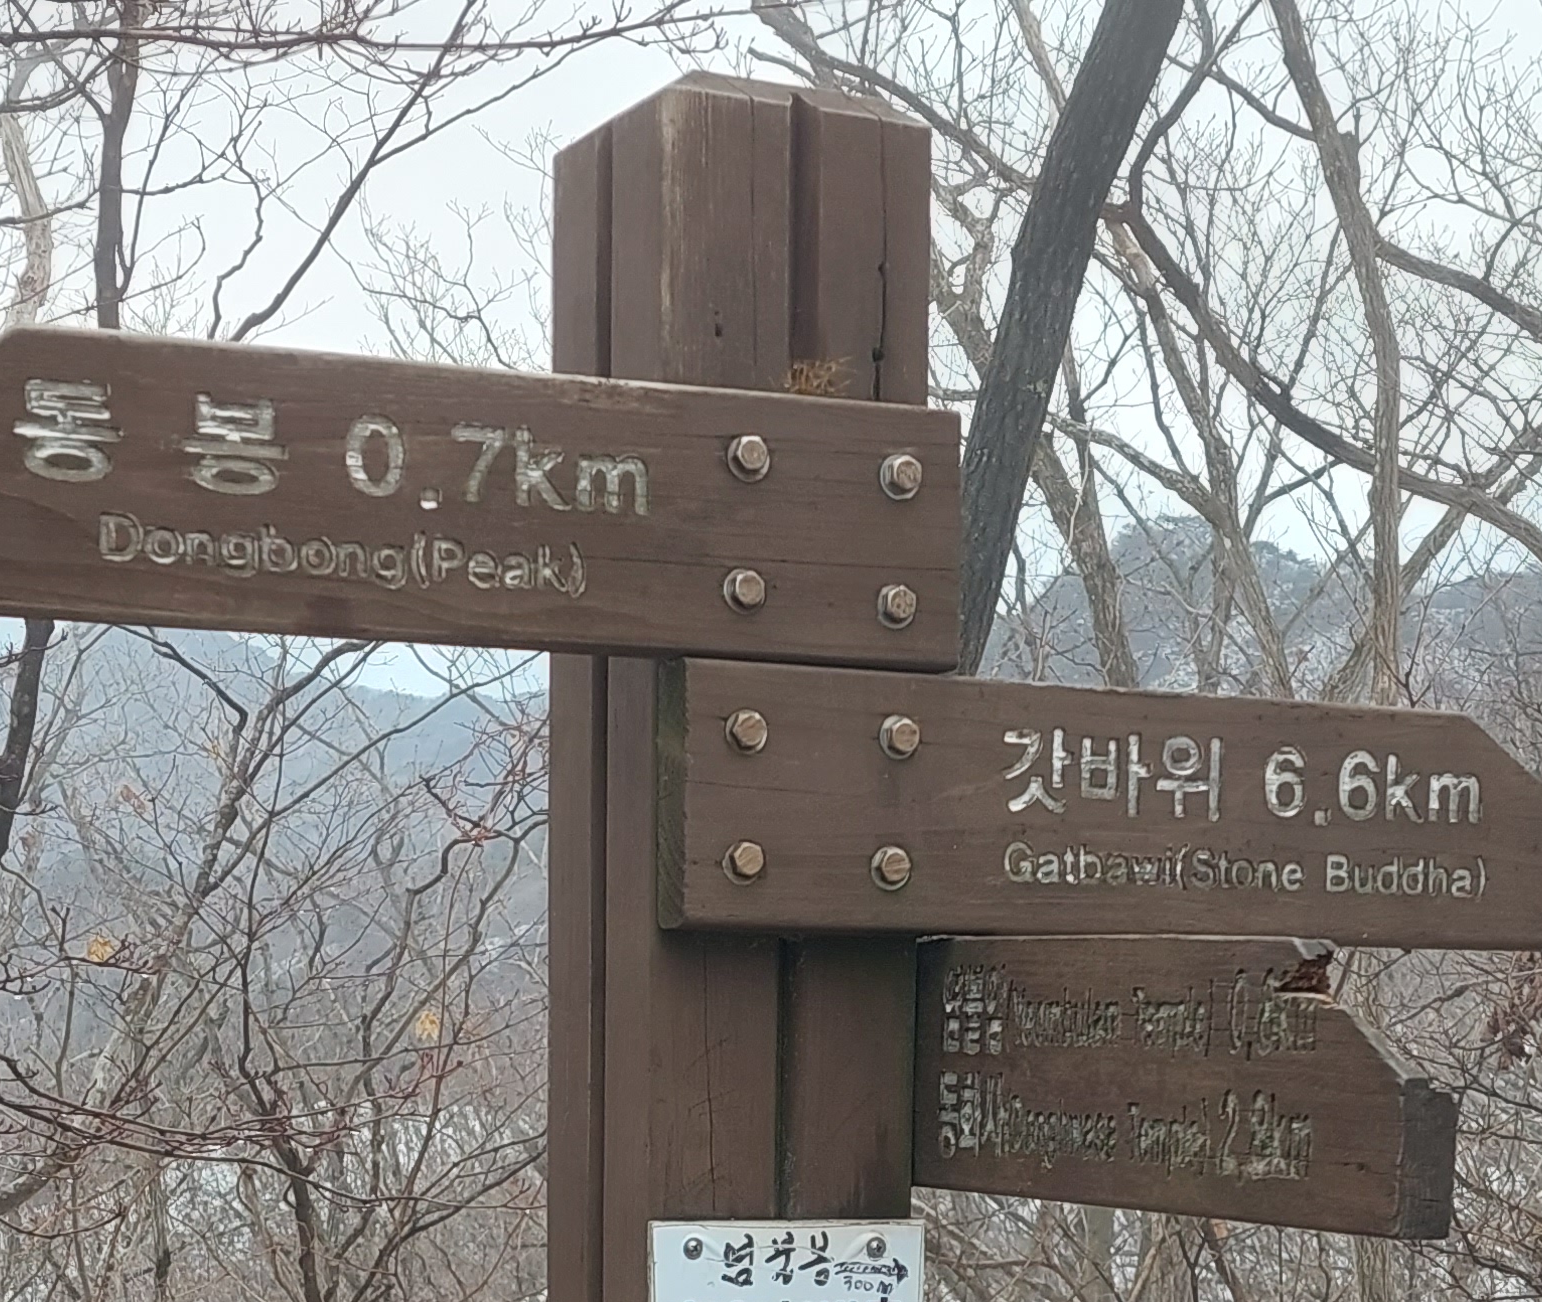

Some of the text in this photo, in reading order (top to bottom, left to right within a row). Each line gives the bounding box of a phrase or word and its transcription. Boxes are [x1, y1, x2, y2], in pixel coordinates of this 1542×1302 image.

[345, 414, 650, 516] 0.7km
[97, 511, 586, 598] Dongbong(Peak)
[1002, 726, 1483, 826] 갓바위 6.6km
[1003, 840, 1487, 899] Gatbawi(Stone Buddha)
